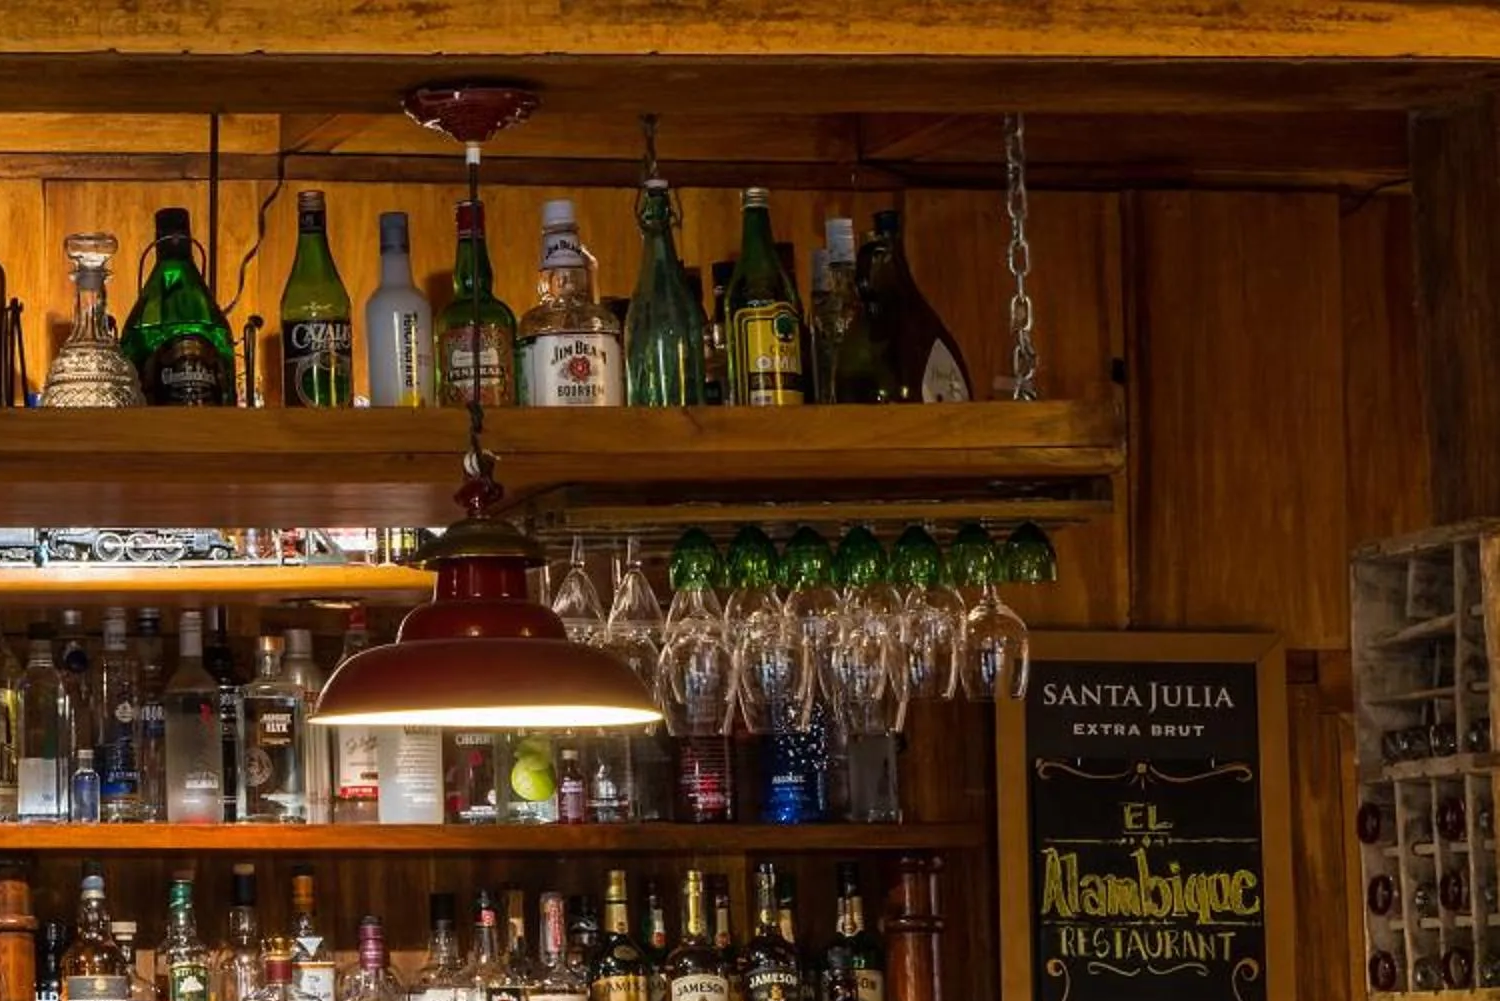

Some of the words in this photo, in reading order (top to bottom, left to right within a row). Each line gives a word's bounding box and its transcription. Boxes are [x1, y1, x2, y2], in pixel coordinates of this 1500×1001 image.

[1043, 682, 1143, 706] SANTA
[1146, 681, 1236, 714] JULIA
[1072, 723, 1142, 737] EXTRA
[1150, 724, 1206, 738] BRUT
[1123, 802, 1174, 830] EL
[1040, 847, 1261, 924] Alambique
[1058, 926, 1237, 961] RESTAURANT
